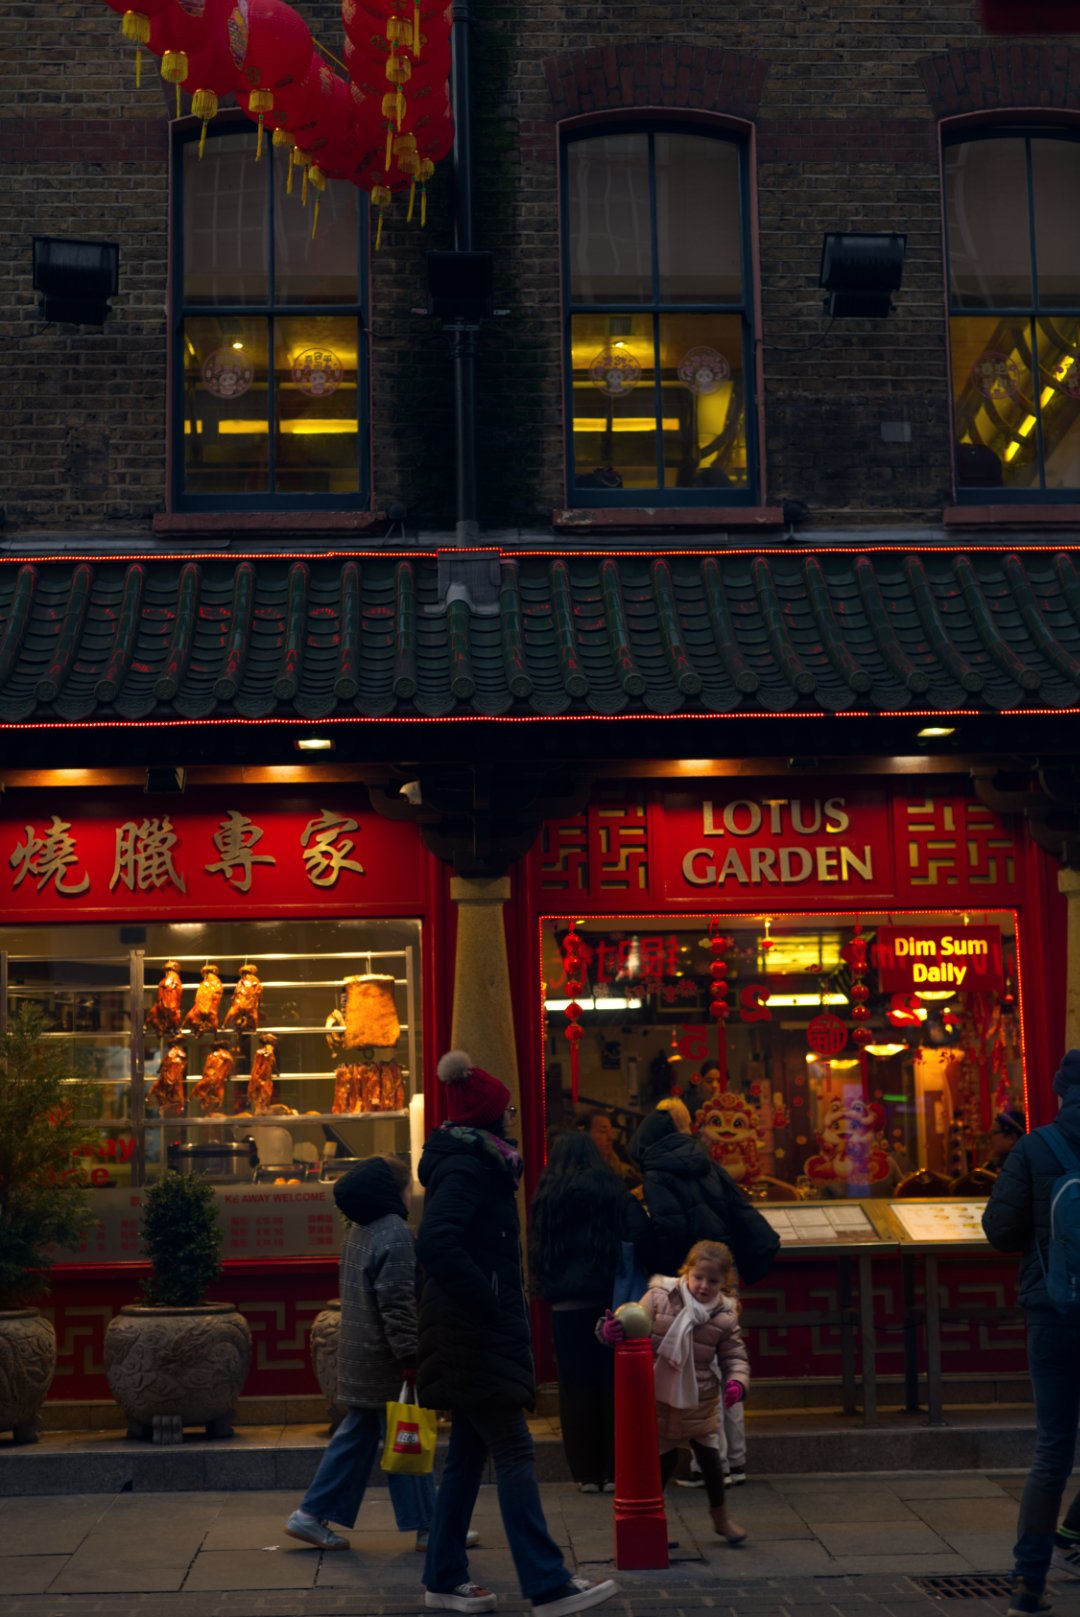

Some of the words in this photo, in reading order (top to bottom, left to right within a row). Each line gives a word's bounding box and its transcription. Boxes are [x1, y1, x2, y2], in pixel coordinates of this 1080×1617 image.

[702, 797, 850, 836] LOTUS
[9, 809, 365, 894] 燒臘專家
[682, 845, 874, 884] GARDEN
[894, 937, 936, 957] Dim
[940, 935, 988, 956] Sum
[912, 962, 967, 985] Daily
[241, 1193, 270, 1204] AWAY
[273, 1191, 326, 1203] WELCOME
